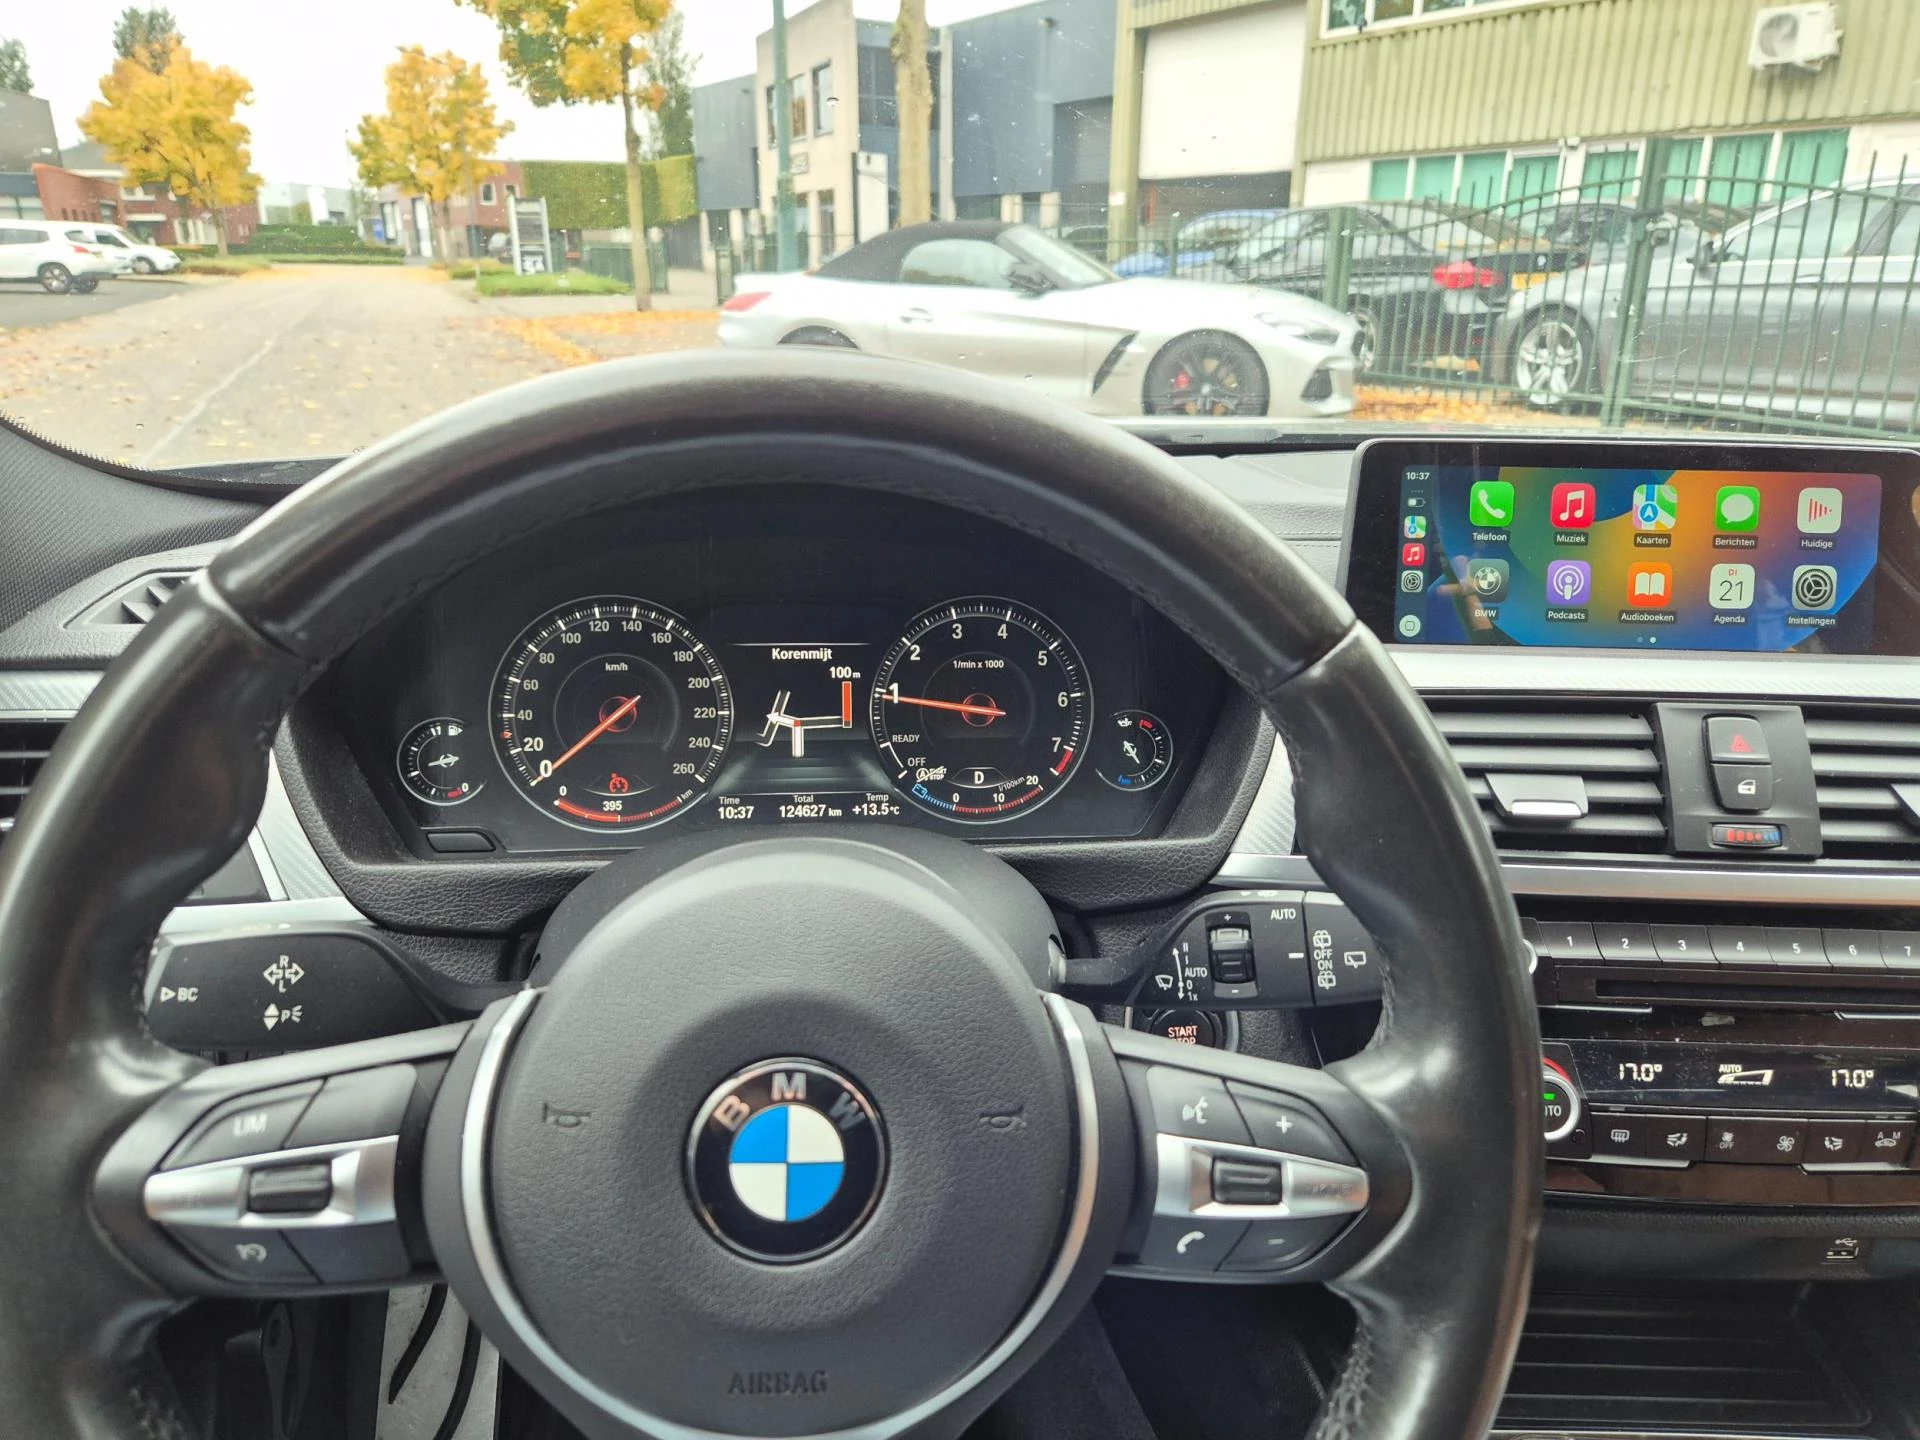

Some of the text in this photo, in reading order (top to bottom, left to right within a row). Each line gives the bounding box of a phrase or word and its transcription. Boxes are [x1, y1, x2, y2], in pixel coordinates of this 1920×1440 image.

[1406, 472, 1430, 480] 10:37
[1472, 533, 1507, 542] Telefoon
[1556, 534, 1586, 543] Muziek
[1636, 536, 1668, 545] Kaarten
[1715, 537, 1755, 547] Berichten
[1801, 539, 1833, 550] Huidige
[1719, 580, 1745, 602] 21
[1474, 609, 1497, 617] BMW
[1548, 611, 1586, 621] Podcasts
[1621, 612, 1674, 623] Audioboeken
[622, 621, 642, 631] 140
[1714, 615, 1745, 626] Agenda
[1788, 616, 1836, 627] Instellingen
[589, 621, 609, 632] 120
[952, 624, 962, 639] 3
[997, 624, 1008, 639] 4
[560, 633, 581, 644] 100
[651, 633, 672, 643] 160
[539, 653, 555, 664] 80
[673, 651, 693, 662] 180
[772, 648, 832, 662] Korenmijt
[910, 645, 921, 661] 2
[1038, 650, 1048, 666] 5
[605, 662, 628, 672] km/h
[953, 660, 975, 669] 1/min
[984, 660, 1004, 669] 1000
[523, 679, 539, 691] 60
[688, 677, 710, 688] 200
[889, 682, 900, 703] 1
[1058, 692, 1068, 707] 6
[517, 710, 533, 721] 40
[694, 707, 716, 718] 220
[689, 738, 711, 748] 240
[892, 734, 920, 743] READY
[523, 737, 544, 752] 20
[1052, 737, 1062, 752] 7
[907, 757, 926, 766] OFF
[539, 760, 552, 778] 0
[673, 763, 695, 775] 260
[974, 771, 984, 784] D
[1026, 776, 1039, 785] 20
[462, 783, 469, 792] 0
[560, 785, 567, 796] 0
[682, 788, 694, 800] km
[793, 794, 814, 803] Total
[866, 793, 889, 802] Temp
[953, 793, 960, 803] 0
[993, 793, 1005, 802] 10
[602, 800, 623, 811] 395
[719, 796, 740, 804] Time
[717, 806, 754, 819] 10:37
[779, 805, 842, 818] 124627 km
[1270, 909, 1296, 920] AUTO
[1566, 936, 1573, 947] 1
[1621, 938, 1630, 949] 2
[1678, 940, 1687, 951] 3
[1736, 942, 1745, 953] 4
[1793, 943, 1801, 954] 5
[1848, 945, 1857, 956] 6
[1904, 947, 1912, 957] 7
[1314, 950, 1333, 960] OFF
[280, 955, 289, 968] R
[1318, 960, 1333, 970] ON
[1184, 967, 1208, 978] AUTO
[279, 980, 286, 993] L
[177, 987, 198, 1001] BC
[1187, 991, 1198, 1001] 1x
[1168, 1025, 1198, 1038] START
[1174, 1037, 1196, 1046] TOP
[1719, 1064, 1742, 1073] AUTO
[714, 1072, 866, 1132] BMW
[1545, 1105, 1562, 1117] TO
[1719, 1141, 1735, 1149] OFF
[727, 1369, 828, 1395] AIRBAG
